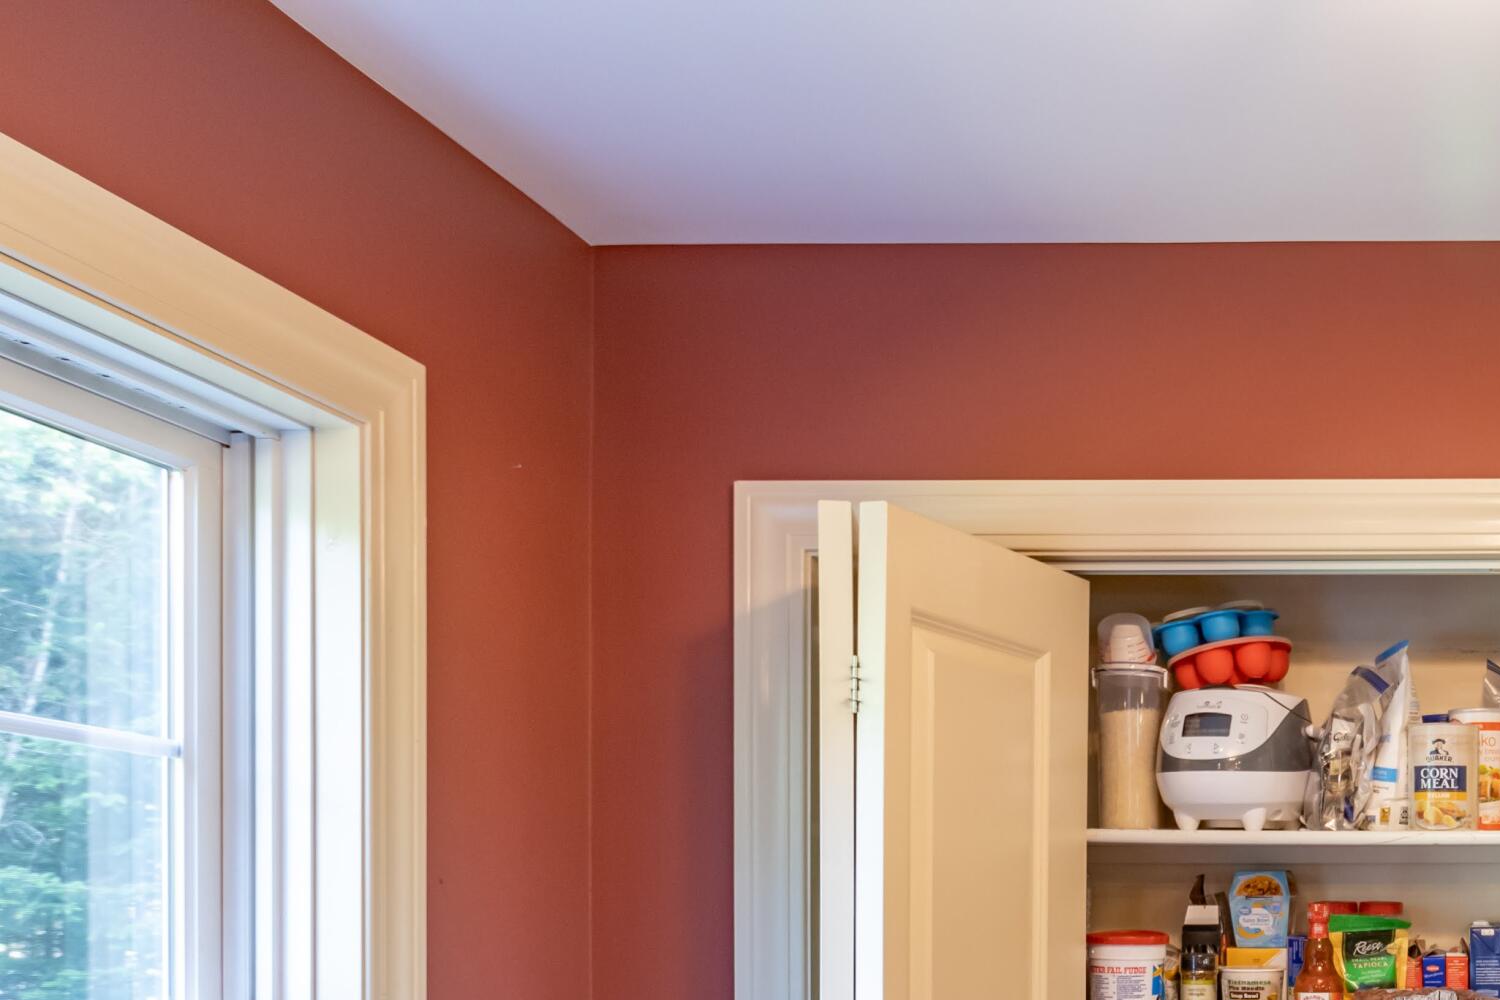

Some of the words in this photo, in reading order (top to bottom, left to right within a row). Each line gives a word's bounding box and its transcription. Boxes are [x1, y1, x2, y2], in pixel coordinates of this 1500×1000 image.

[1420, 767, 1459, 779] CORN
[1420, 779, 1459, 790] MEAL
[1124, 966, 1147, 974] FUDGE
